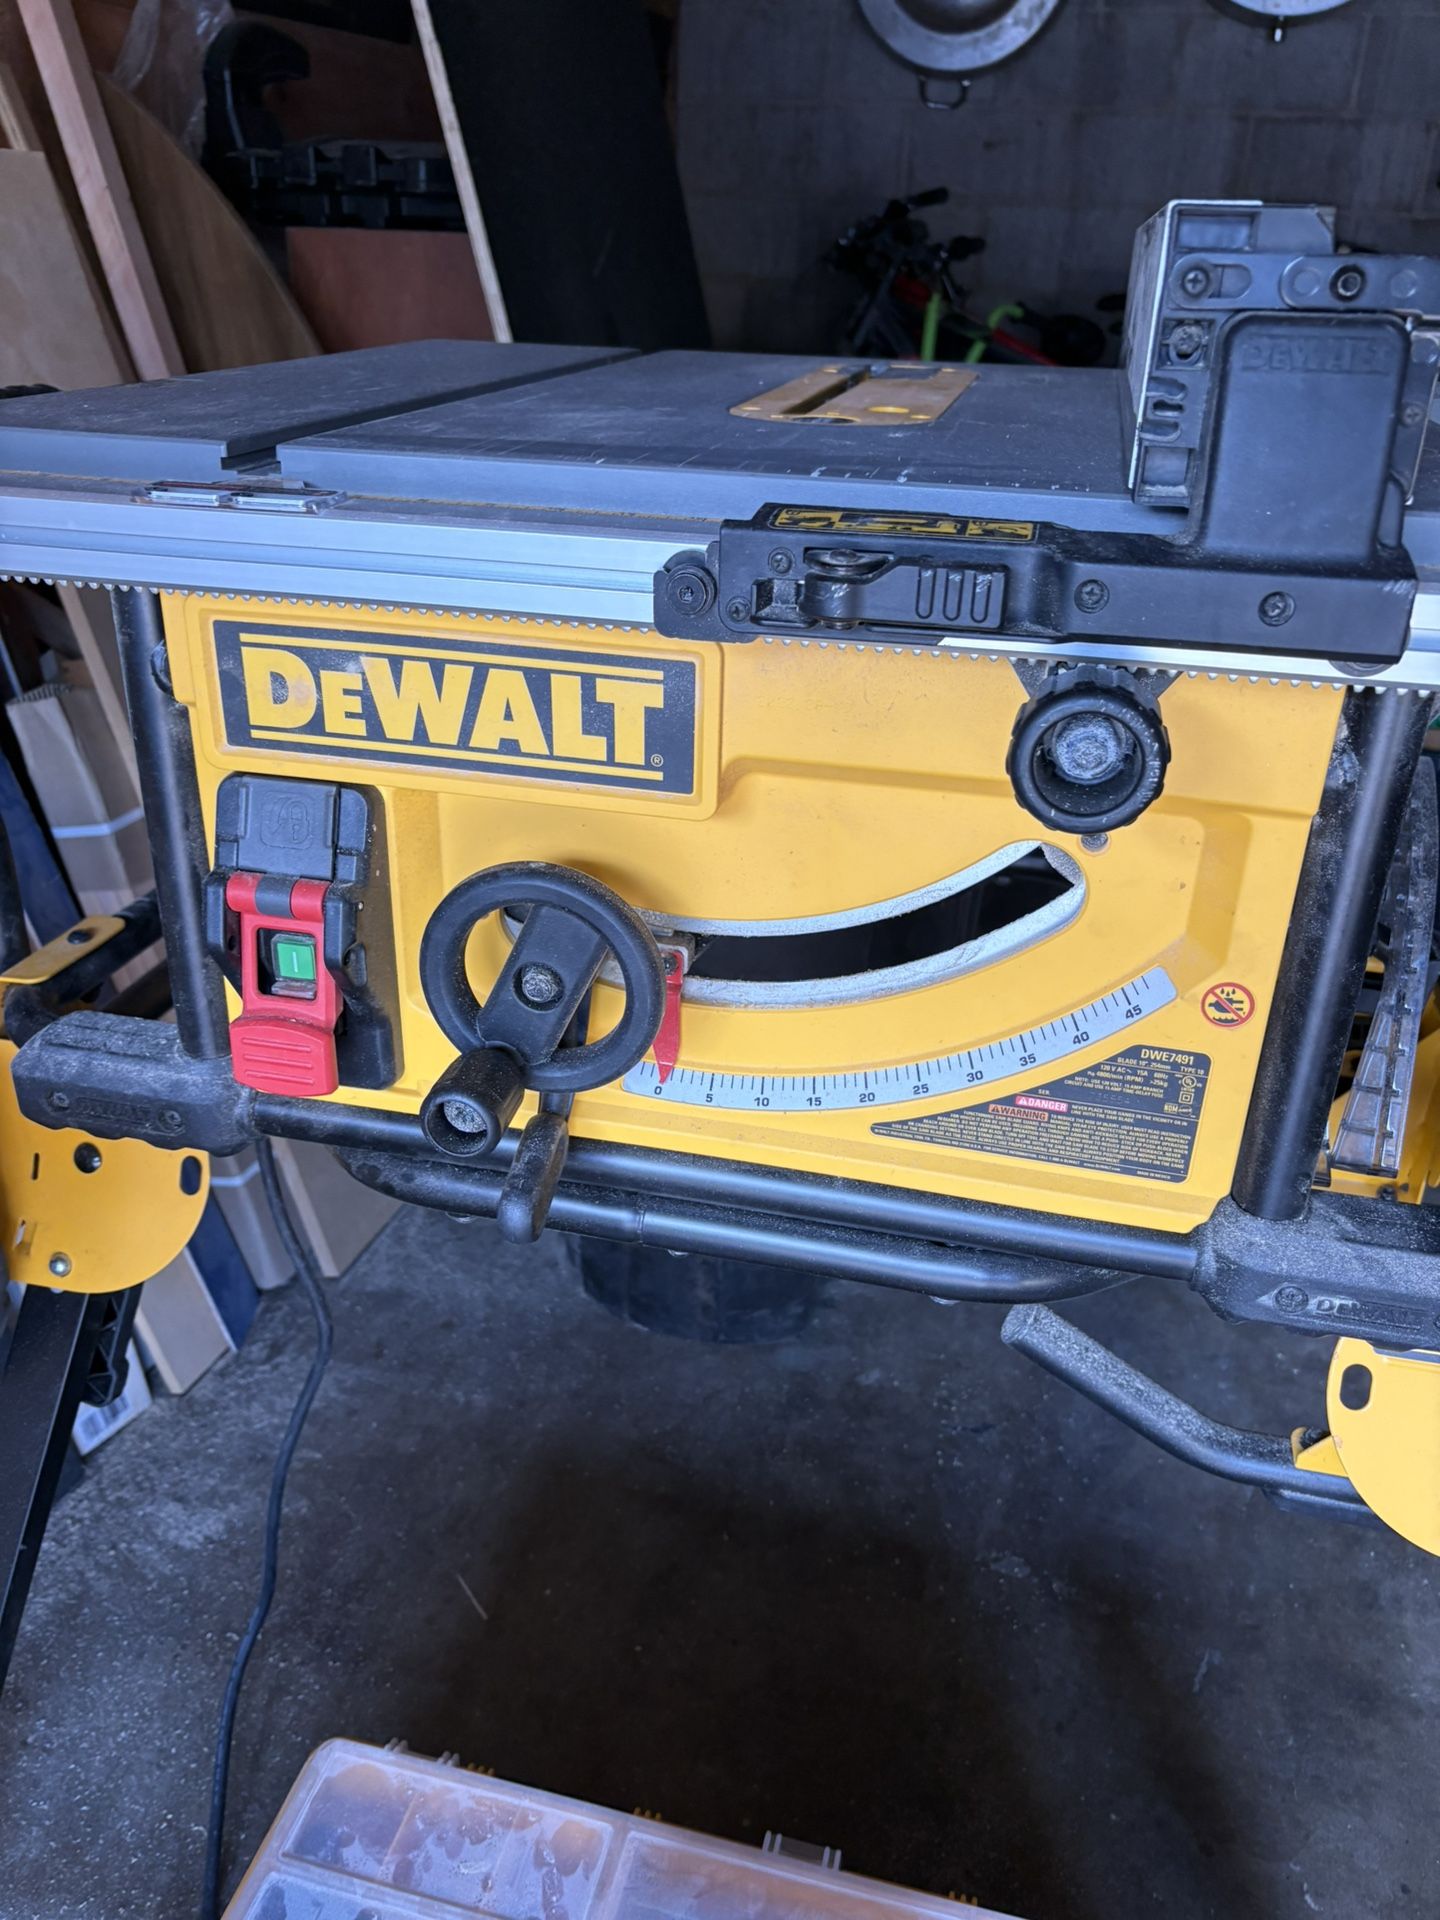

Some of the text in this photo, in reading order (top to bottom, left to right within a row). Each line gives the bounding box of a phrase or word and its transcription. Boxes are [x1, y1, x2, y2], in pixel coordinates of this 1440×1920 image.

[654, 1001, 1143, 1107] 0 5 10 15 20 25 30 35 40 45
[1140, 1049, 1194, 1065] DWE7491
[1118, 1057, 1137, 1065] BLADE
[1180, 1066, 1196, 1074] TYPE
[1124, 1075, 1144, 1084] (RPM)
[1027, 1098, 1067, 1112] DANGER
[1001, 1107, 1046, 1120] WARNING
